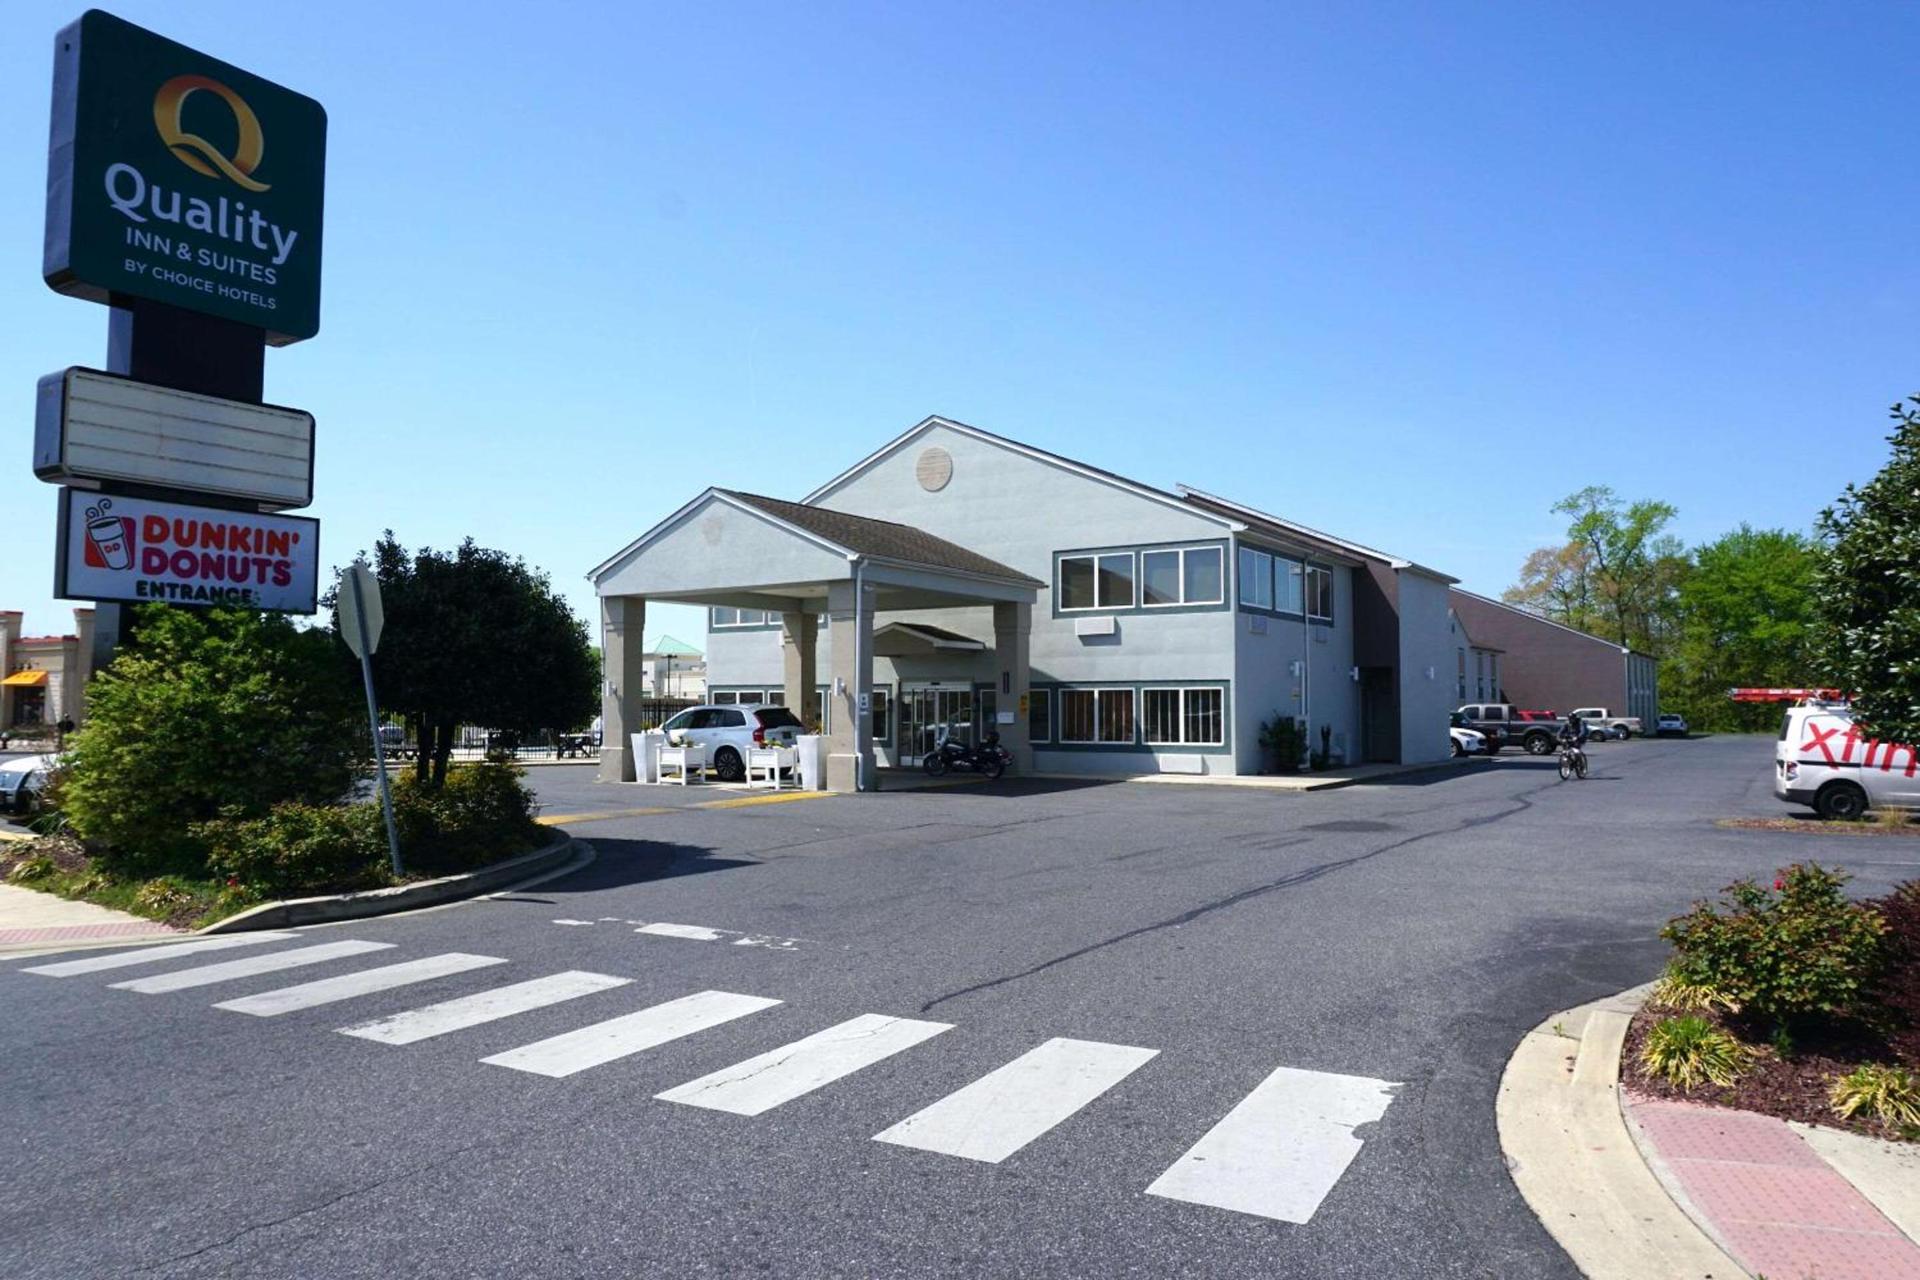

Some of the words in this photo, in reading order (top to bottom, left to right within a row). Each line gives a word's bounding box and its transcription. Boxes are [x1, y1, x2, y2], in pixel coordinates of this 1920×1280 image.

[153, 73, 272, 193] Q
[104, 162, 298, 265] Quality
[126, 226, 171, 256] INN
[177, 242, 193, 261] &
[198, 248, 277, 285] SUITES
[124, 258, 148, 275] BY
[152, 266, 214, 293] CHOICE
[218, 284, 277, 310] HOTELS
[142, 514, 300, 557] DUNKIN'
[135, 579, 253, 602] ENTRANCE
[141, 546, 292, 587] DONUTS
